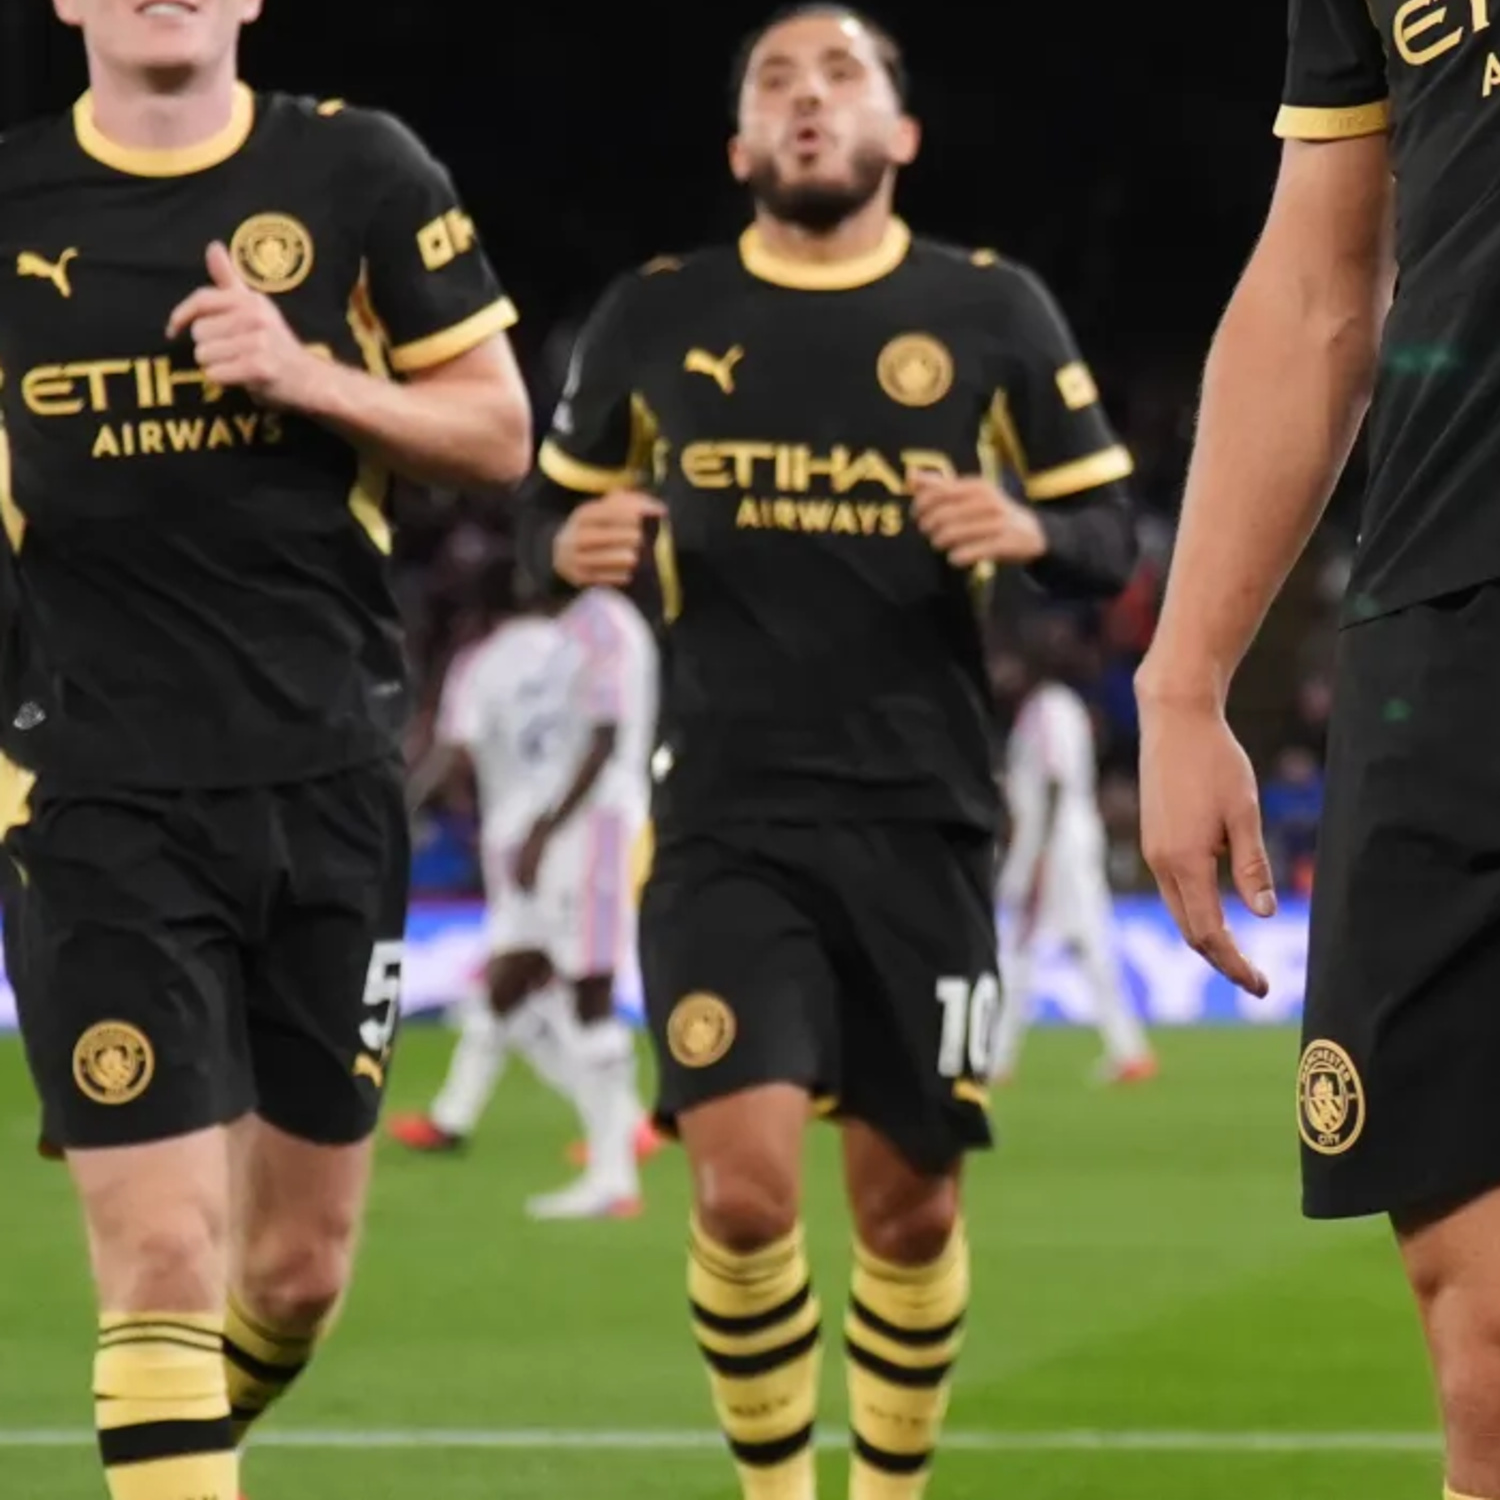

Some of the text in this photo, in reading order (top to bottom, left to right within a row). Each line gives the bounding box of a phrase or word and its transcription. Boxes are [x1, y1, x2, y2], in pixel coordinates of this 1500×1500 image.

[91, 411, 282, 458] AIRWAYS
[735, 498, 903, 537] AIRWAYS
[359, 940, 402, 1050] 5
[936, 975, 998, 1077] 10
